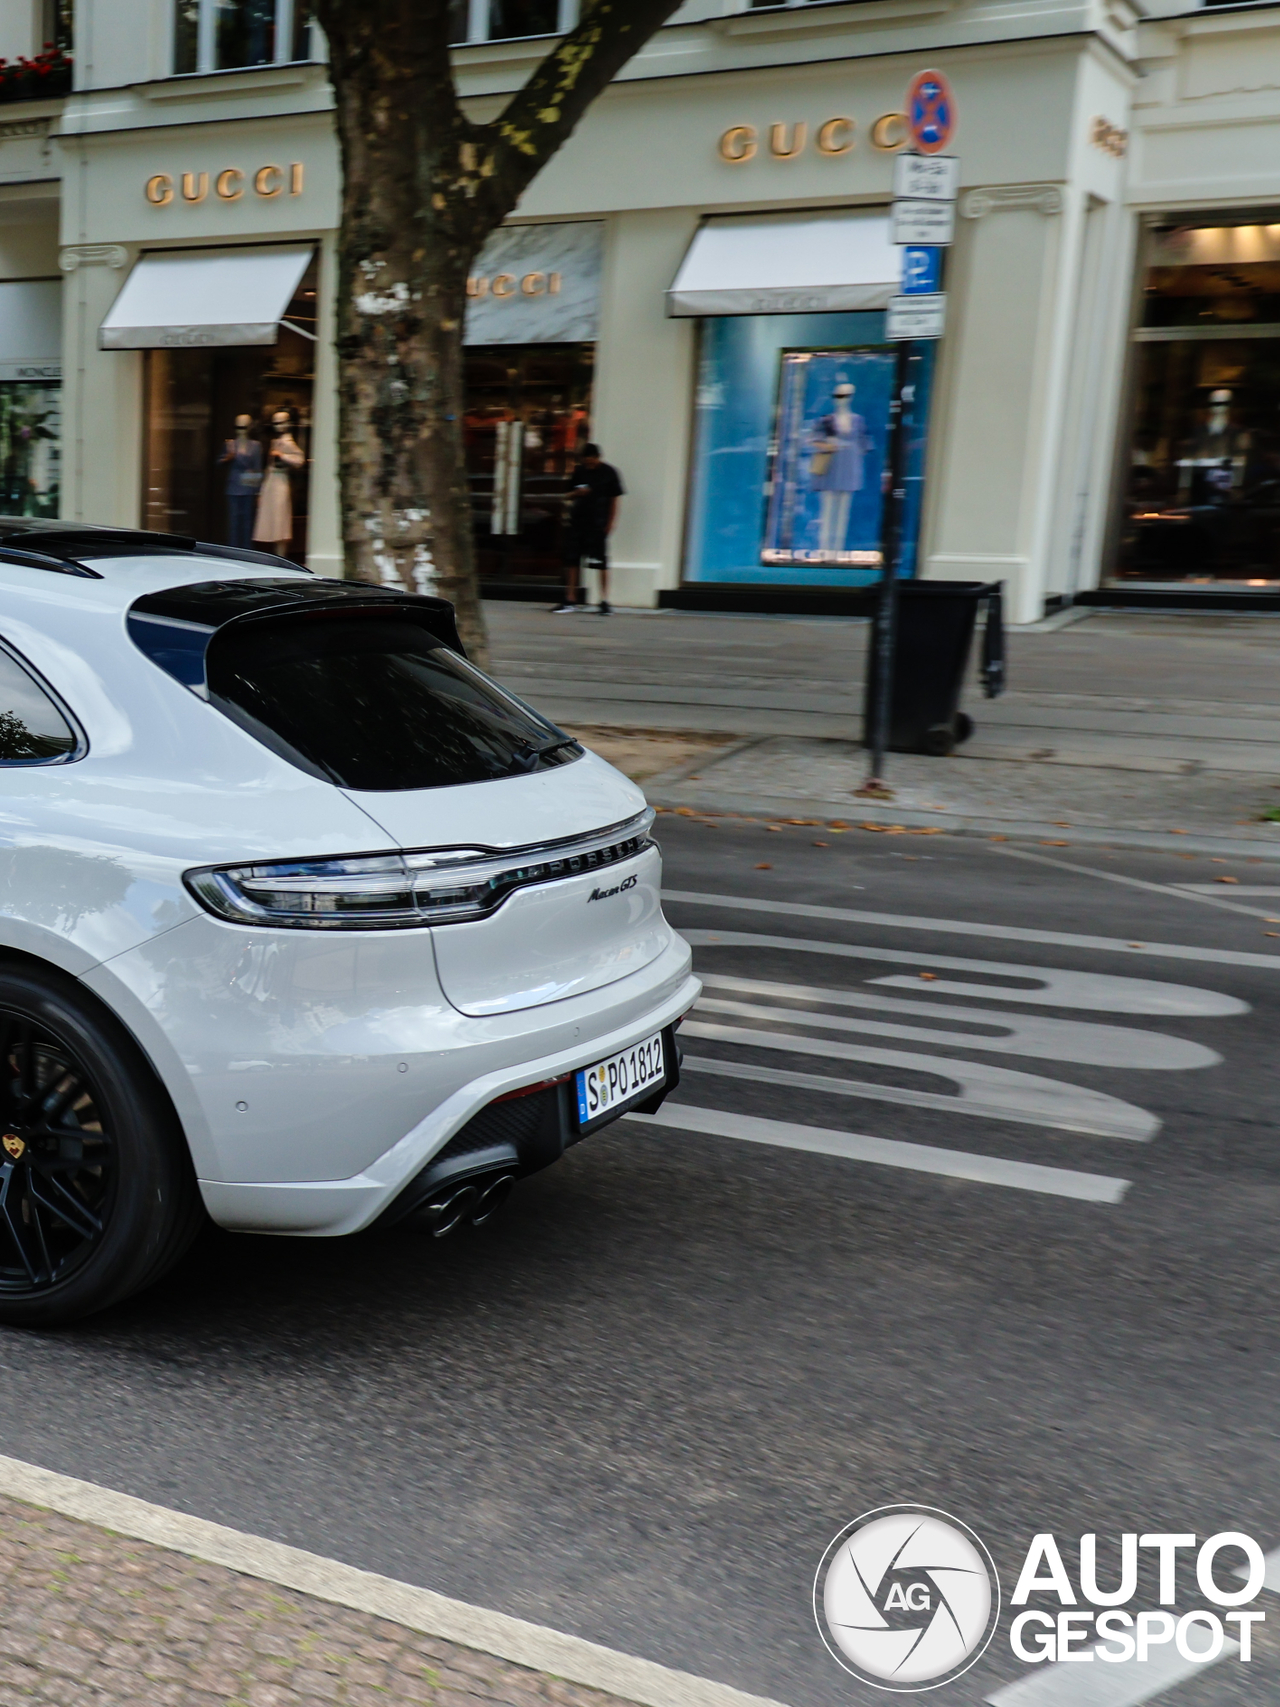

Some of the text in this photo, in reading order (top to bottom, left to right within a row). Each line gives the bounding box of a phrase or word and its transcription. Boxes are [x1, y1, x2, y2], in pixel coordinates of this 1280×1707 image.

[718, 112, 910, 162] GUCC
[146, 161, 304, 206] GUCCI
[465, 271, 562, 298] UCCI
[587, 874, 638, 903] Macan GTS
